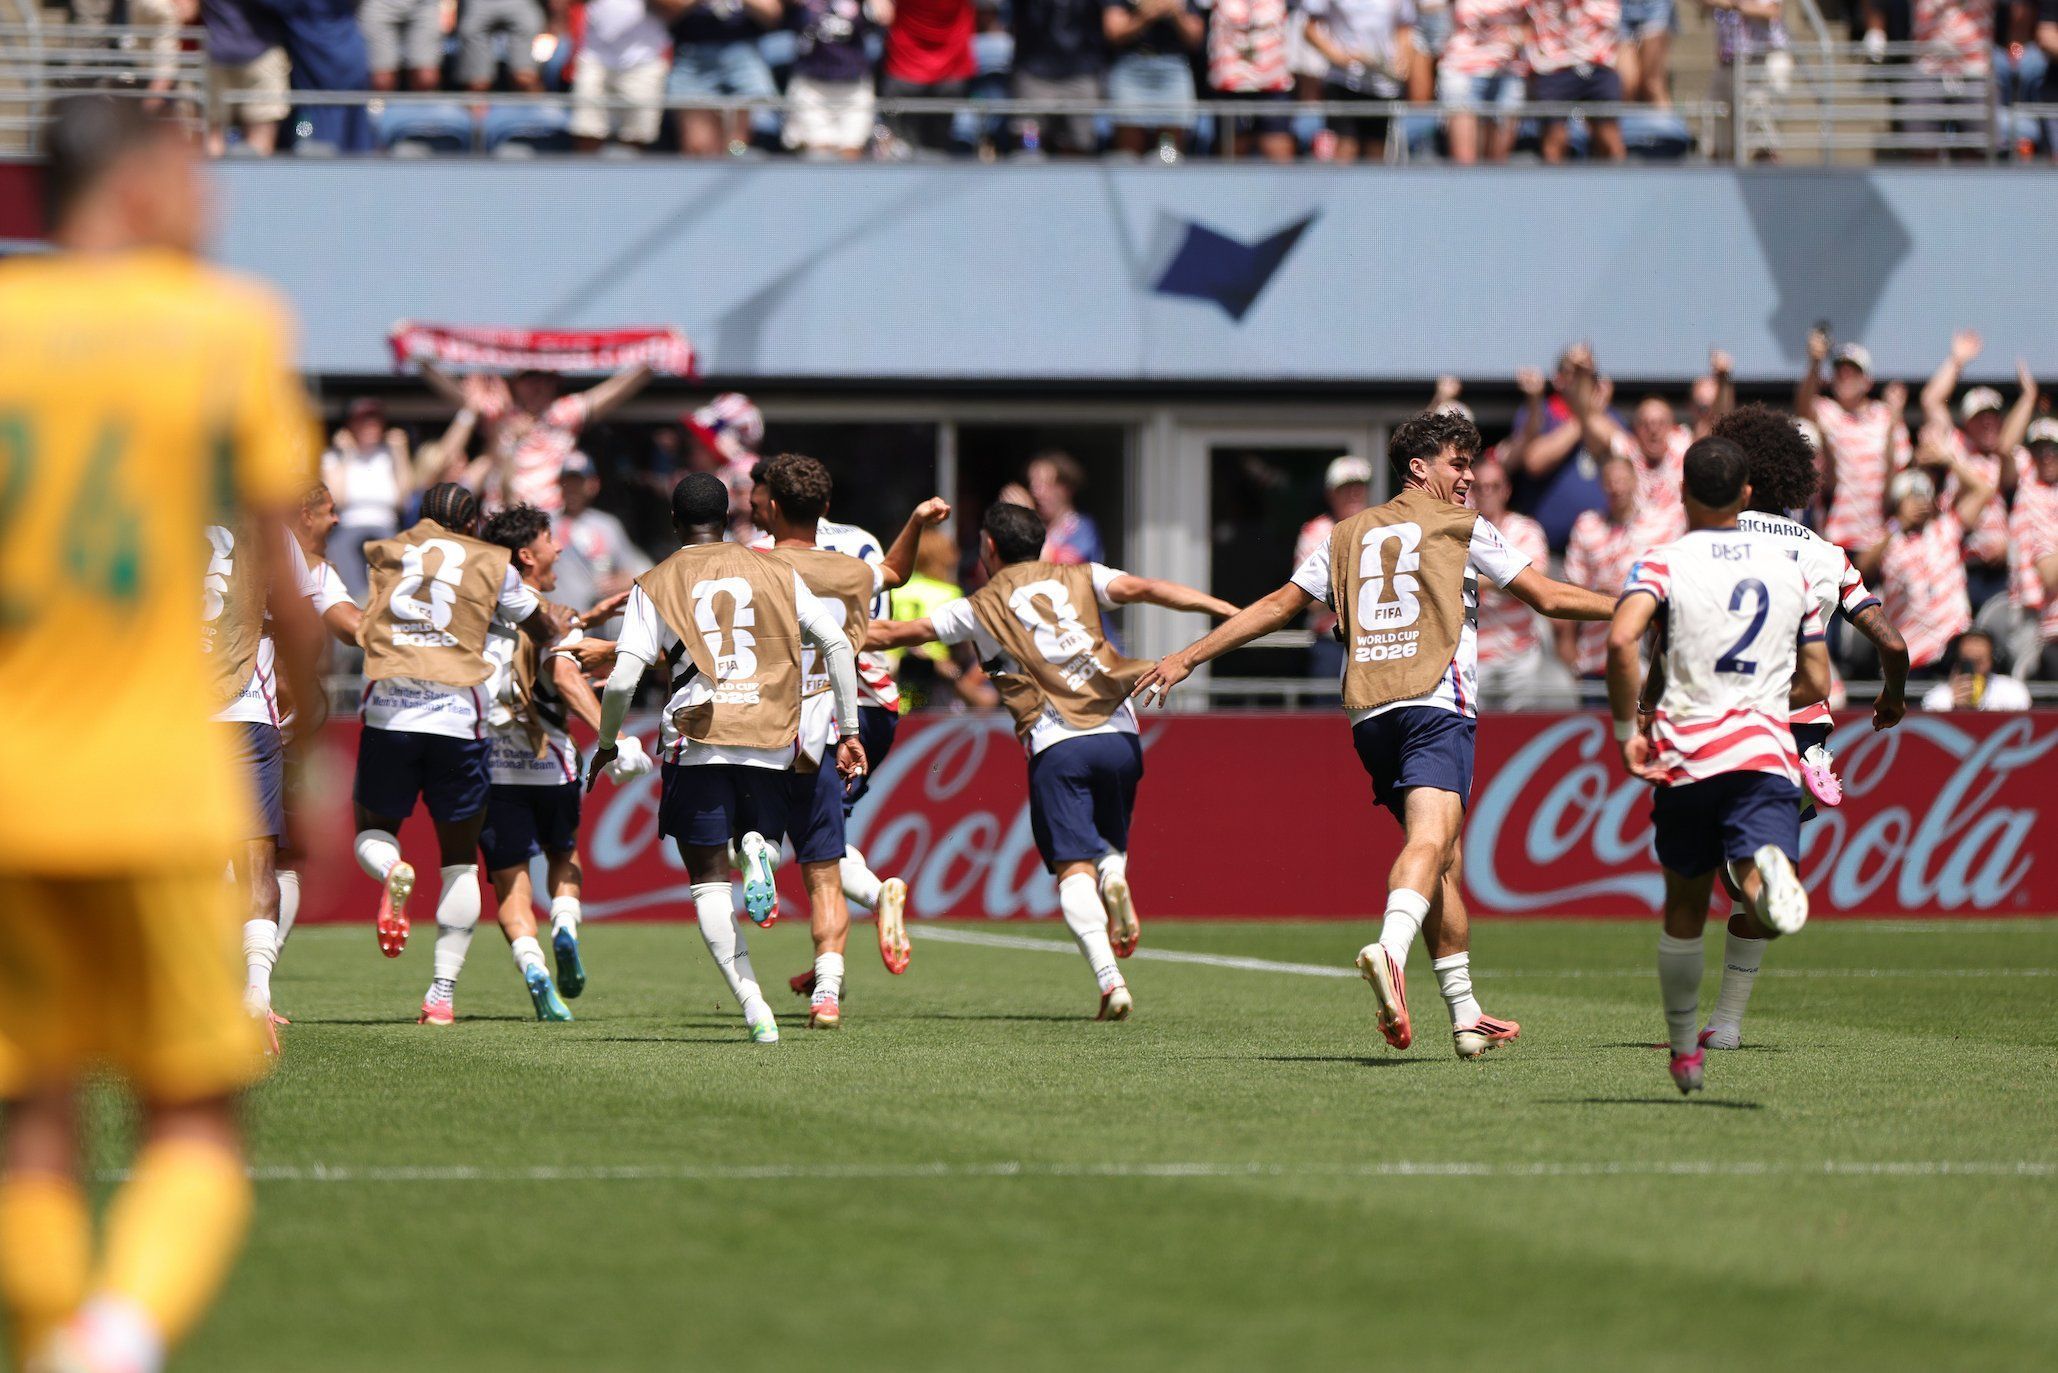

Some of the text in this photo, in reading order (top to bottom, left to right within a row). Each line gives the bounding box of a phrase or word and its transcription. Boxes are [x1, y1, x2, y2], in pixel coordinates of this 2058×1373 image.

[1738, 518, 1811, 541] RICHARDS
[1711, 543, 1752, 561] DEST
[1374, 606, 1403, 620] FIFA
[1715, 578, 1771, 674] 2
[1357, 630, 1420, 646] WORLD CUP
[1354, 641, 1418, 663] 2026
[239, 689, 260, 699] eam
[712, 691, 760, 704] 026
